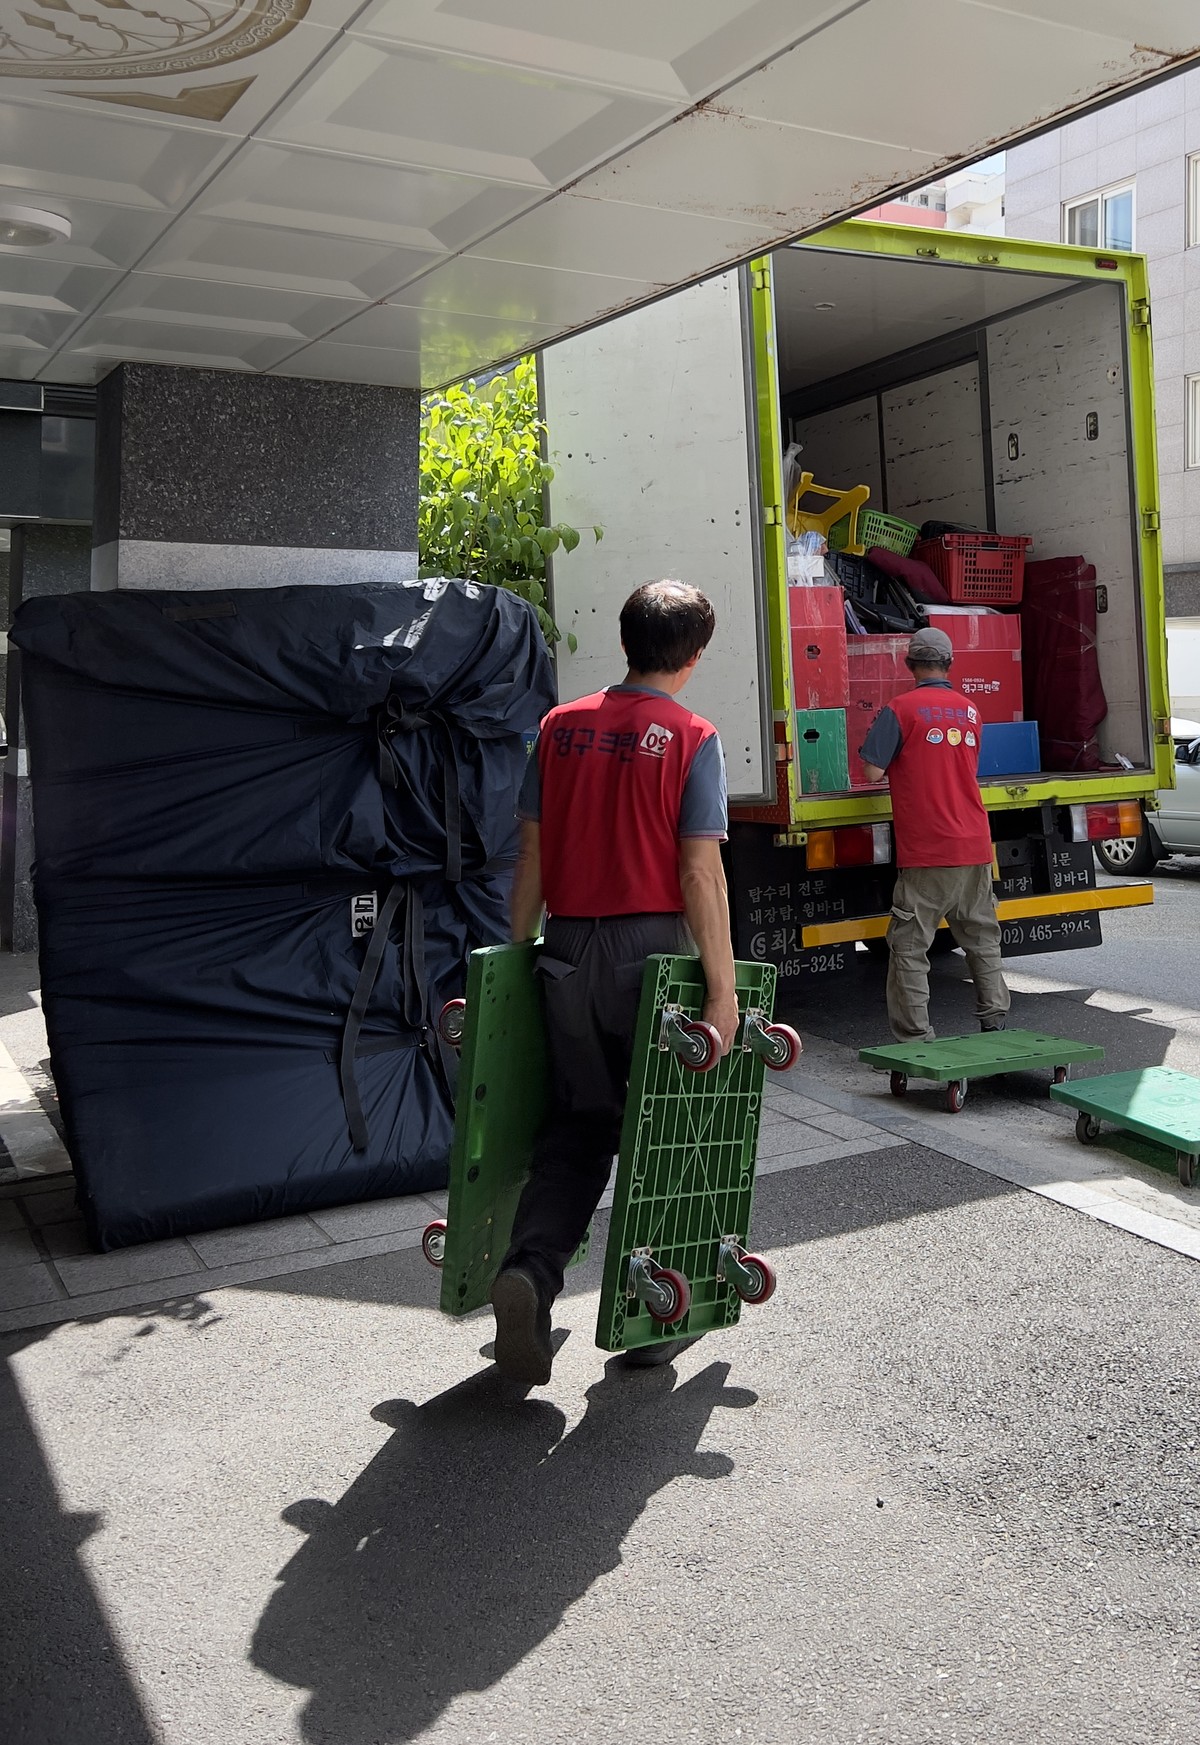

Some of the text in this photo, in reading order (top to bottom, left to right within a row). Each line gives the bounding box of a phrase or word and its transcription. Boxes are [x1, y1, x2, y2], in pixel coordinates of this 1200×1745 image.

[553, 728, 639, 762] 영구크린
[747, 879, 827, 904] 탑수리 전문
[1003, 876, 1033, 893] 내장
[802, 898, 845, 918] 윙바디
[1003, 926, 1024, 945] 02)
